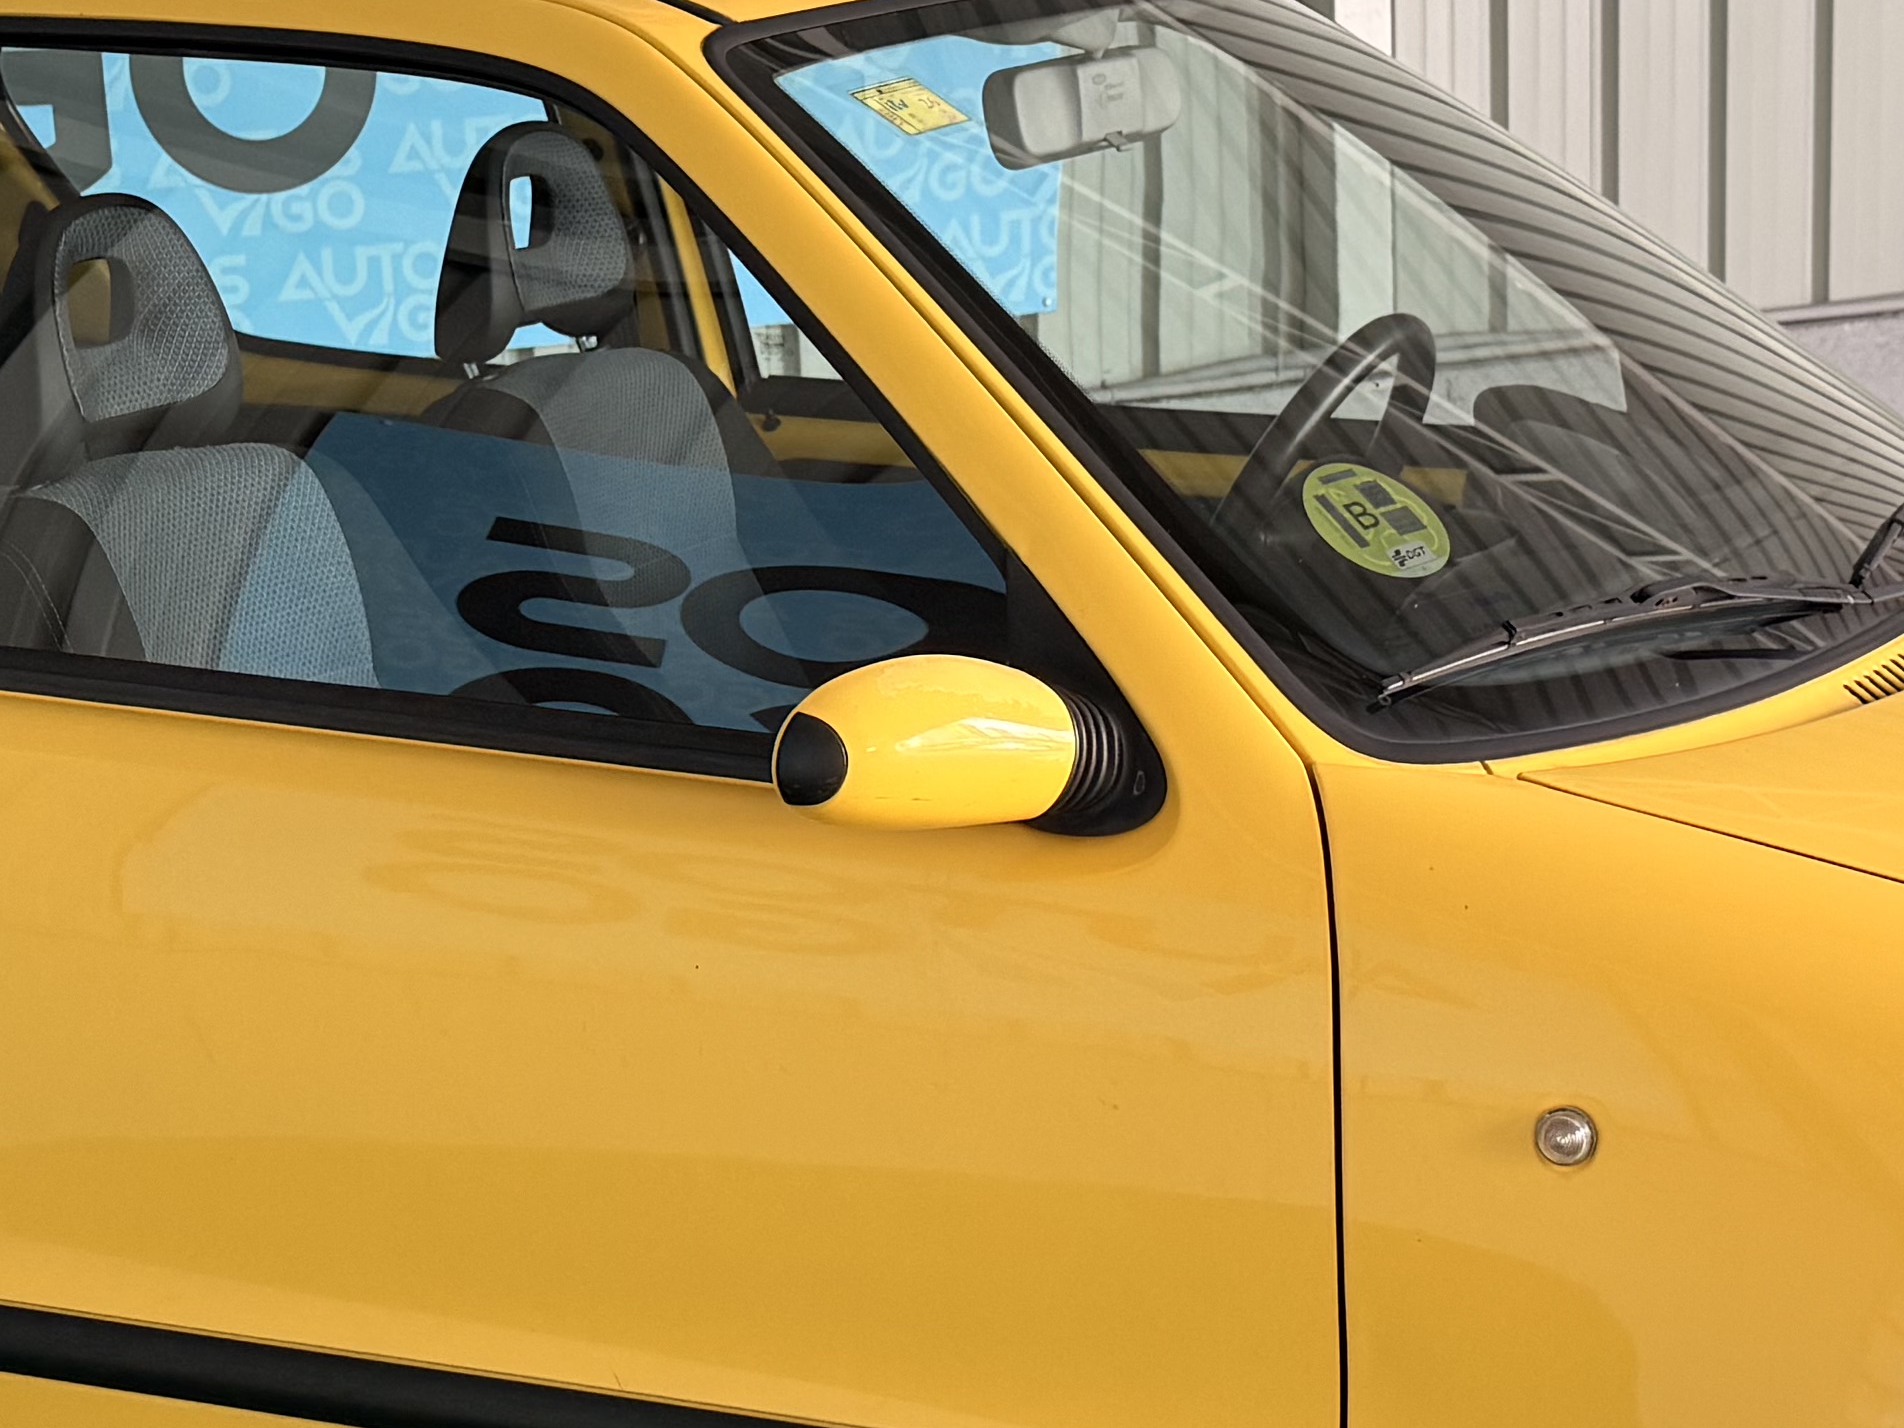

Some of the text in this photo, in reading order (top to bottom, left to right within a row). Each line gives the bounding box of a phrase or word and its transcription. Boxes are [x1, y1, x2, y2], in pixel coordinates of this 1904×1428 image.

[278, 241, 449, 303] AUTO
[325, 295, 437, 348] VIG
[1343, 501, 1380, 531] B
[1405, 545, 1426, 561] DGT
